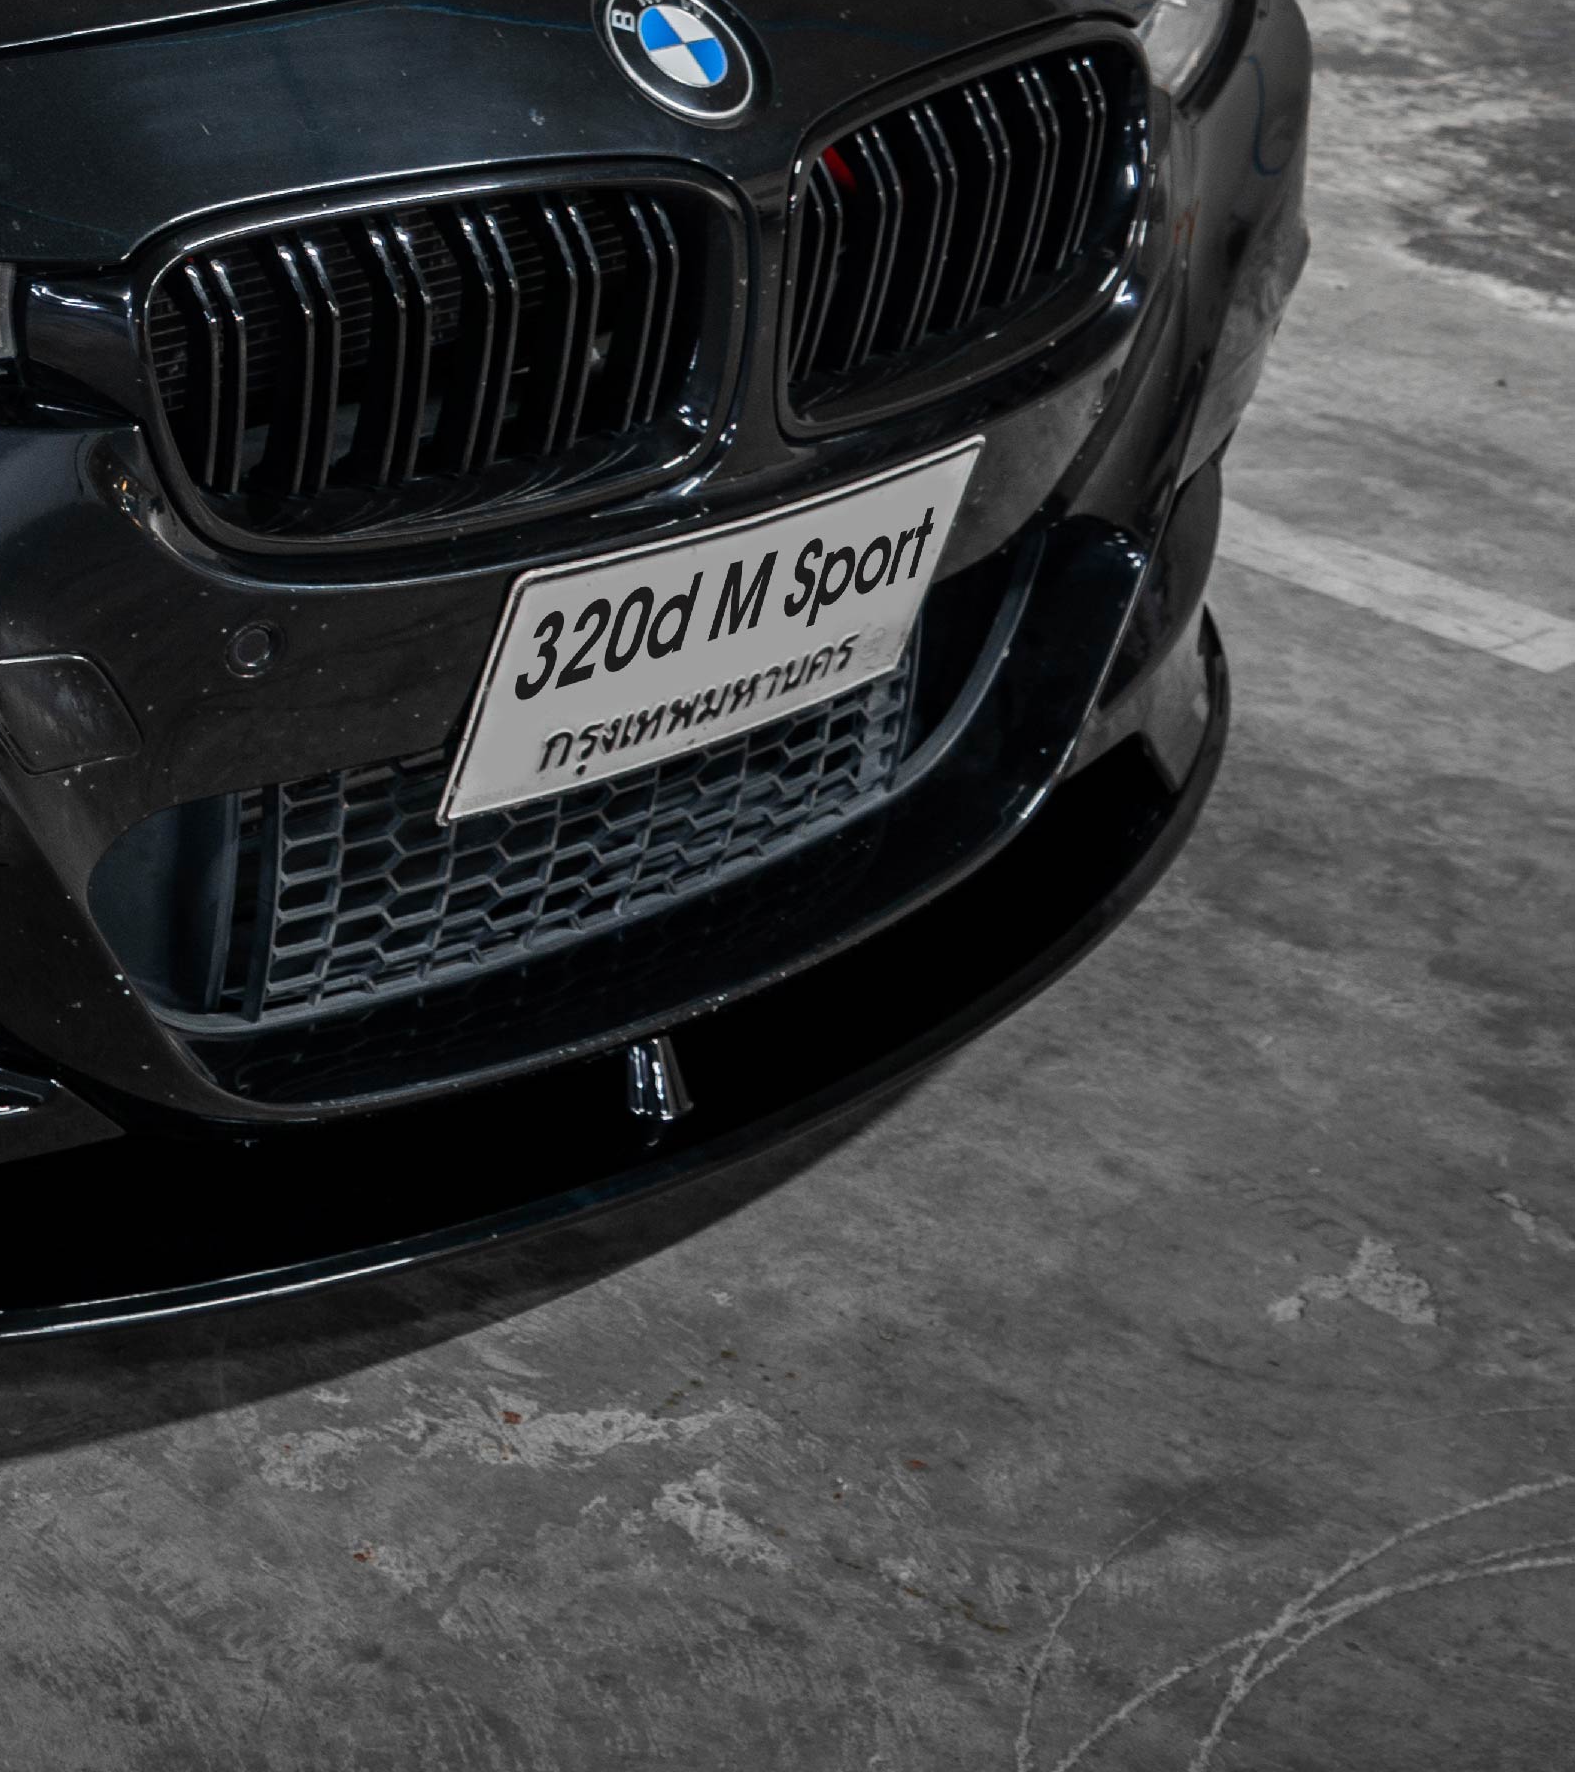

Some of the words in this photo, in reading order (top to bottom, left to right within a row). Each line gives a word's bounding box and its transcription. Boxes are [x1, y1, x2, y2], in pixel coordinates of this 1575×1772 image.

[514, 571, 703, 700] 320d
[707, 550, 779, 642] M
[783, 507, 935, 627] Sport
[536, 631, 859, 775] กรุงเทพมหานคร
